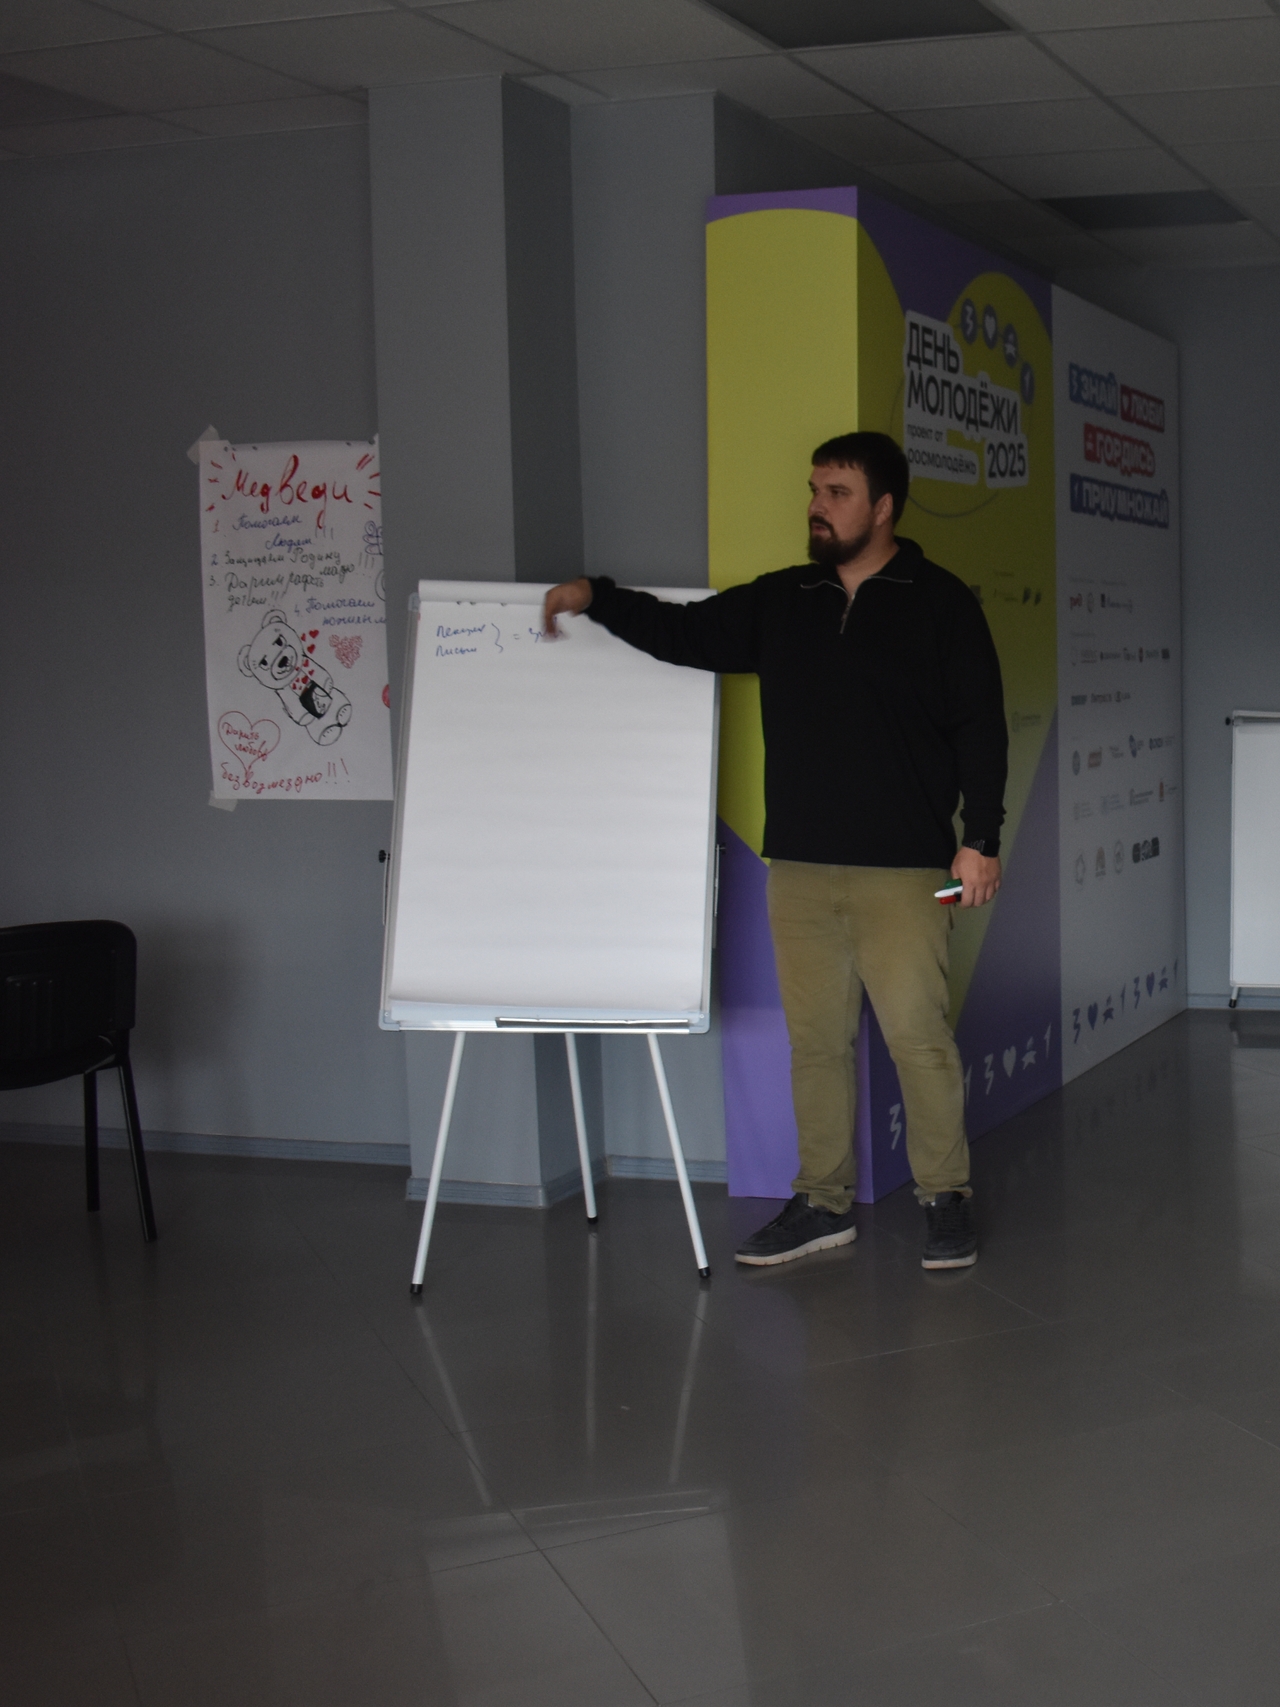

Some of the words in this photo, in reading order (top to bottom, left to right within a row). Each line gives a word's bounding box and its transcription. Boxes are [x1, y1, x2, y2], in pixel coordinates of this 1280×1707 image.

[907, 321, 960, 375] ДЕНЬ
[907, 370, 1018, 436] МОЛОДЁЖИ
[1080, 371, 1117, 415] ЗНАЙ
[907, 424, 933, 442] проект
[935, 430, 944, 443] от
[1096, 432, 1155, 475] ГОРДИСЬ
[987, 442, 1027, 479] 2025
[222, 454, 353, 530] Медведи
[1082, 481, 1169, 527] ПРИУМНОЖАЙ
